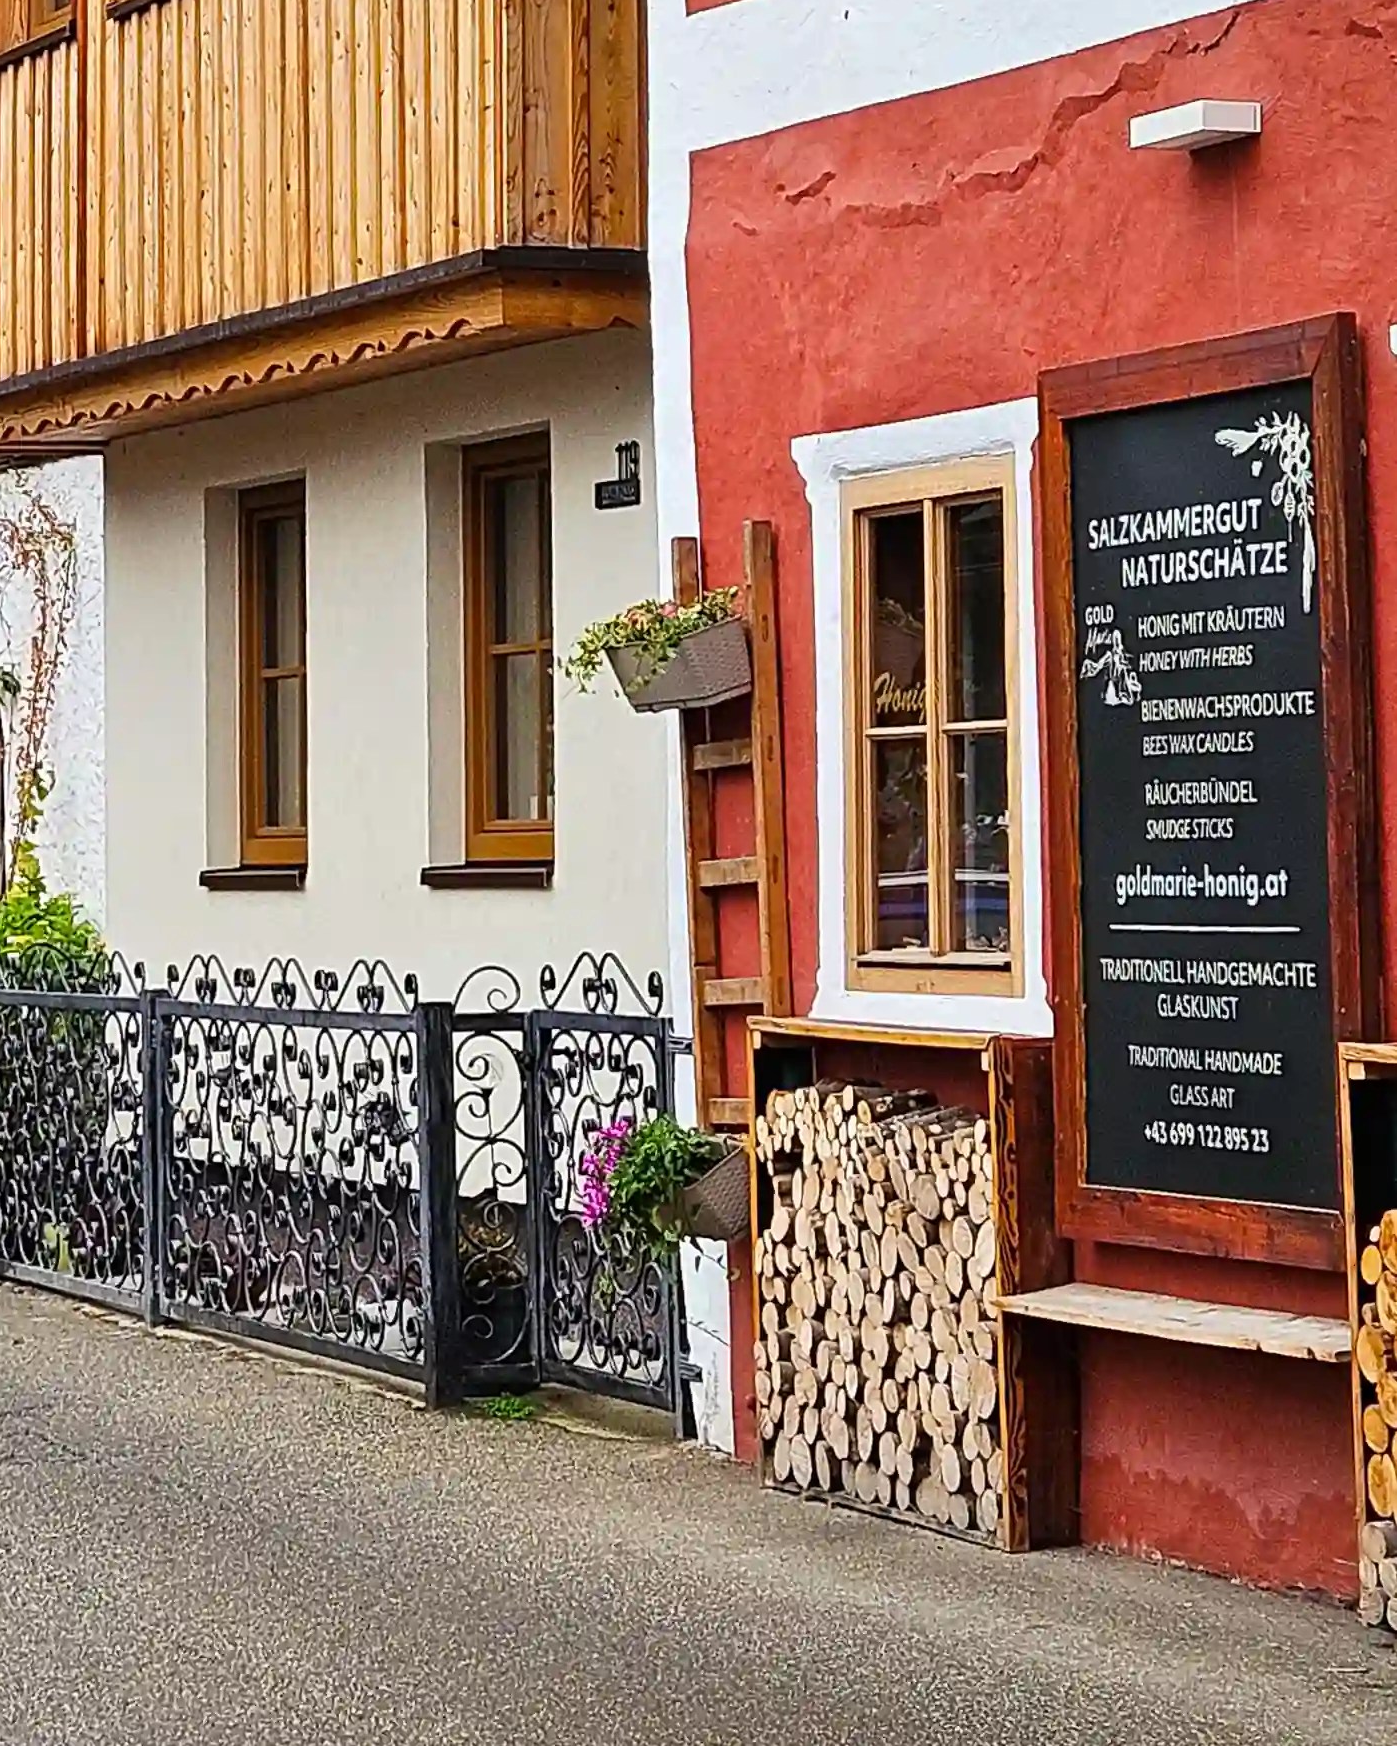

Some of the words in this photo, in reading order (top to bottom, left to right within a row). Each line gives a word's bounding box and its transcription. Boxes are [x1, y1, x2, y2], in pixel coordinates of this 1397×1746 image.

[1088, 498, 1262, 550] SALZKAMMERGUT
[1121, 538, 1289, 588] NATURSCHÄTZE
[1085, 604, 1115, 626] GOLD
[1138, 614, 1180, 638] HONIG
[1182, 611, 1206, 635] MIT
[1207, 605, 1285, 633] KRÄUTERN
[1139, 650, 1179, 672] HONEY
[1179, 648, 1210, 669] WITH
[1212, 645, 1254, 667] HERBS
[1141, 691, 1316, 722] BIENENWACHSPRODUKTE
[1142, 735, 1168, 756] BEES
[1168, 734, 1195, 755] WAX
[1196, 731, 1255, 754] CANDLES
[1145, 778, 1258, 806] RÄUCHERBÜNDEL
[1146, 818, 1191, 840] SMUDGE
[1192, 818, 1234, 839] STICKS
[1116, 863, 1289, 906] goldmarie-honig.at
[1099, 958, 1186, 984] TRADITIONELL
[1186, 960, 1317, 988] HANDGEMACHTE
[1157, 993, 1240, 1020] GLASKUNST
[1127, 1044, 1203, 1071] TRADITIONAL
[1205, 1050, 1283, 1075] HANDMADE
[1170, 1084, 1209, 1106] GLASS
[1211, 1087, 1235, 1109] ART
[1144, 1120, 1168, 1145] +43
[1169, 1122, 1195, 1146] 699
[1197, 1124, 1224, 1149] 122
[1224, 1126, 1250, 1152] 895
[1250, 1128, 1270, 1153] 23
